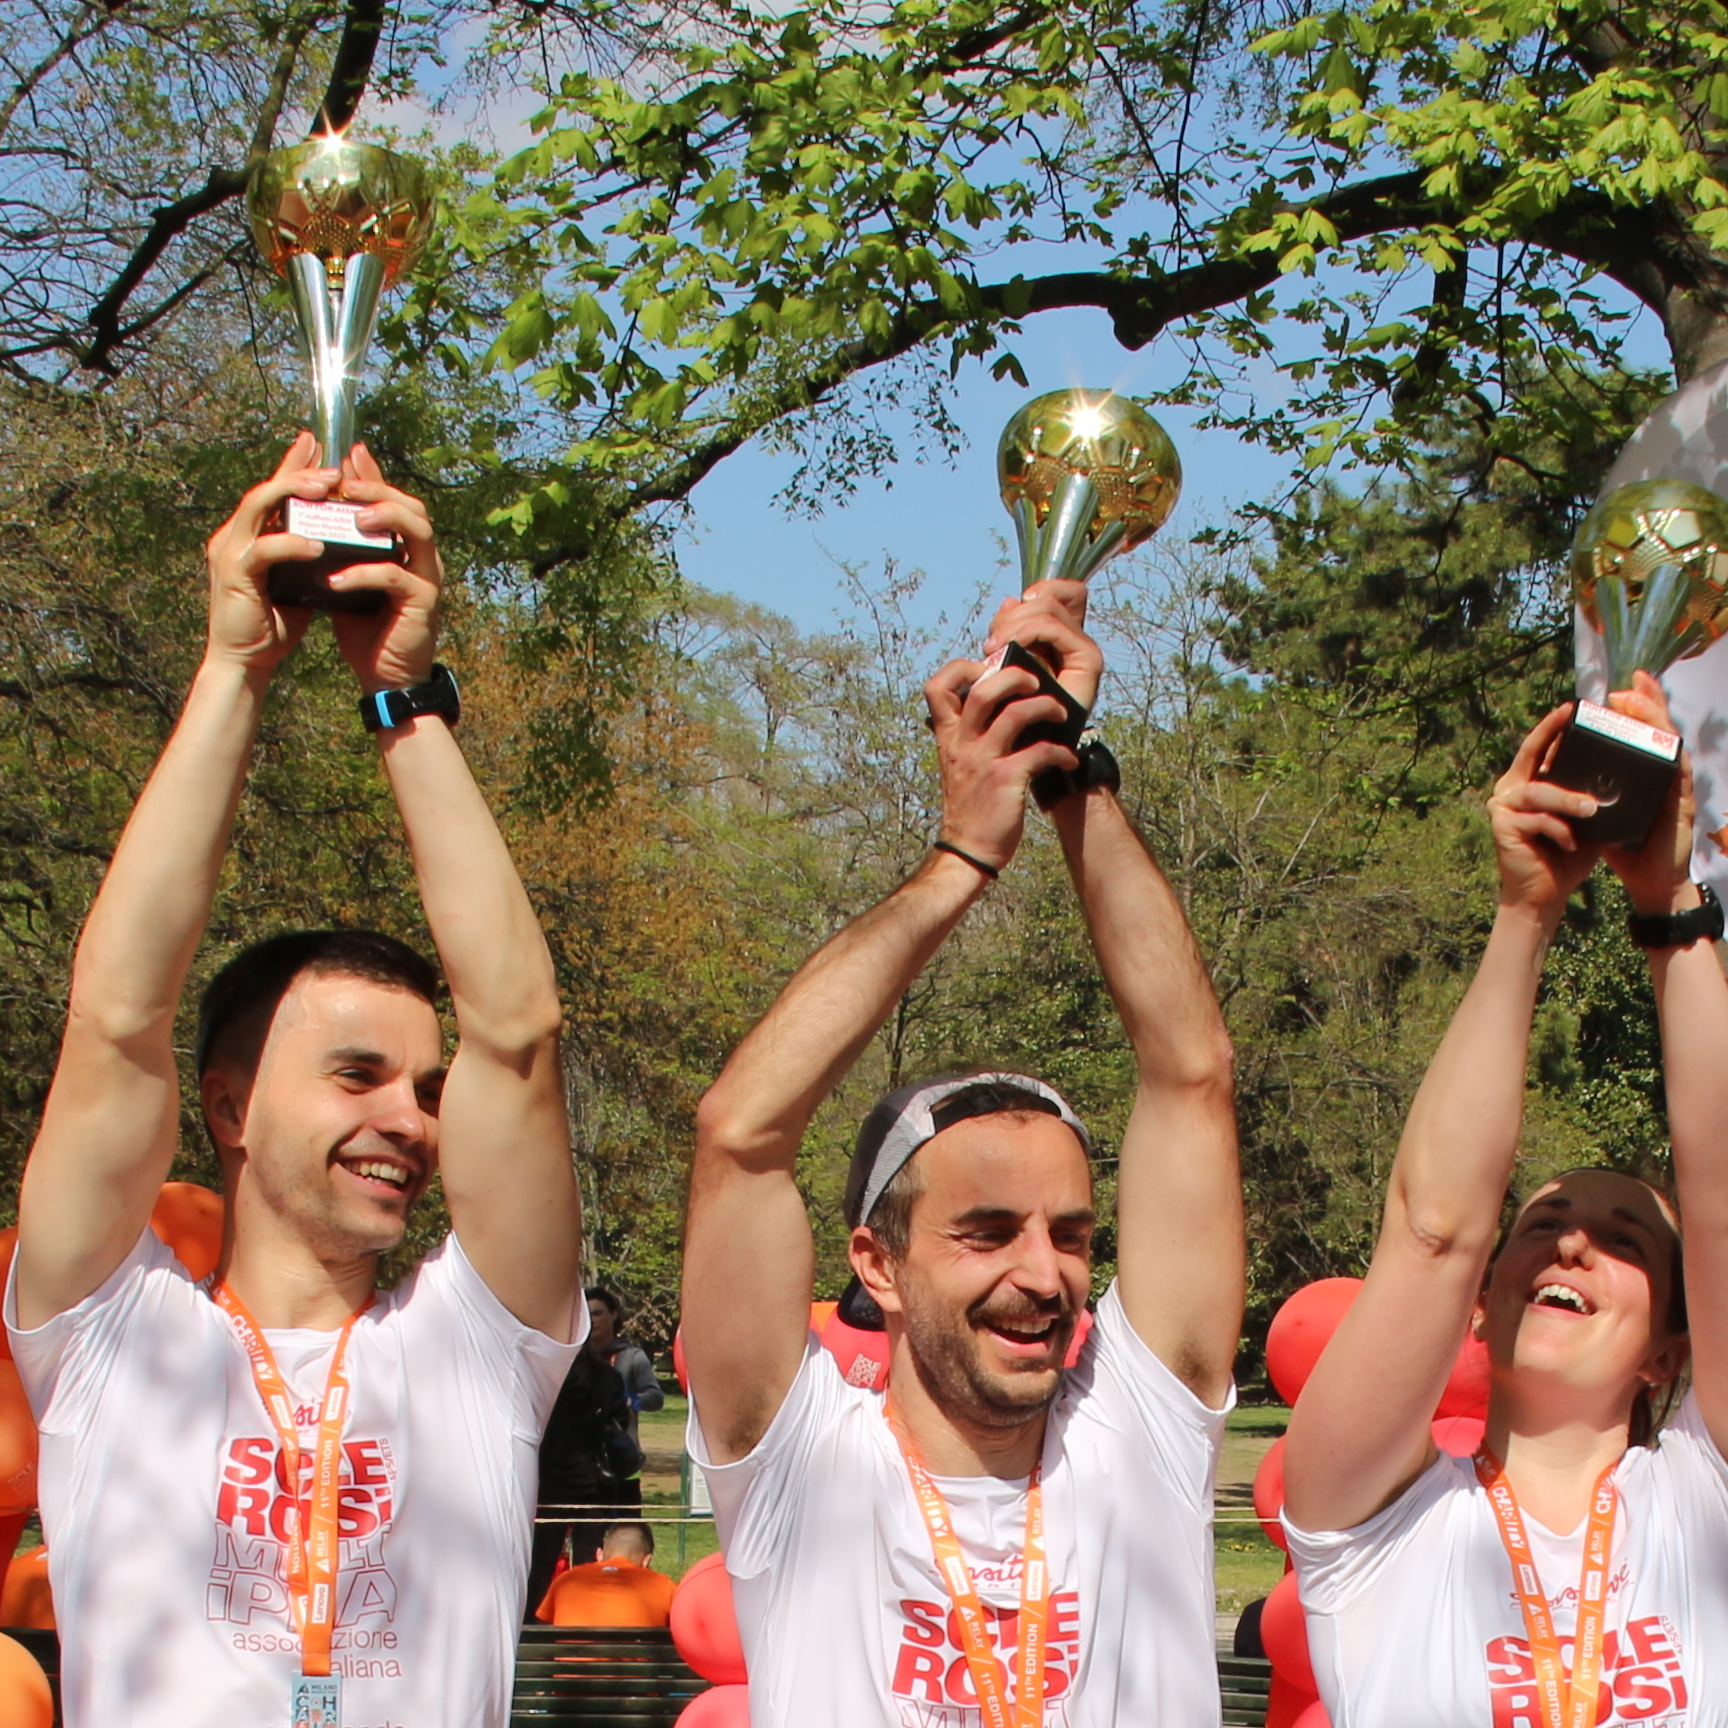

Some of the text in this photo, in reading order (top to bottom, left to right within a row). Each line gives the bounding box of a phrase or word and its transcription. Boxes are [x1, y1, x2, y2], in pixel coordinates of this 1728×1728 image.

[214, 1523, 391, 1583] MLT
[206, 1568, 397, 1633] iPA
[233, 1627, 398, 1651] assozione
[1025, 1623, 1038, 1675] EDITION
